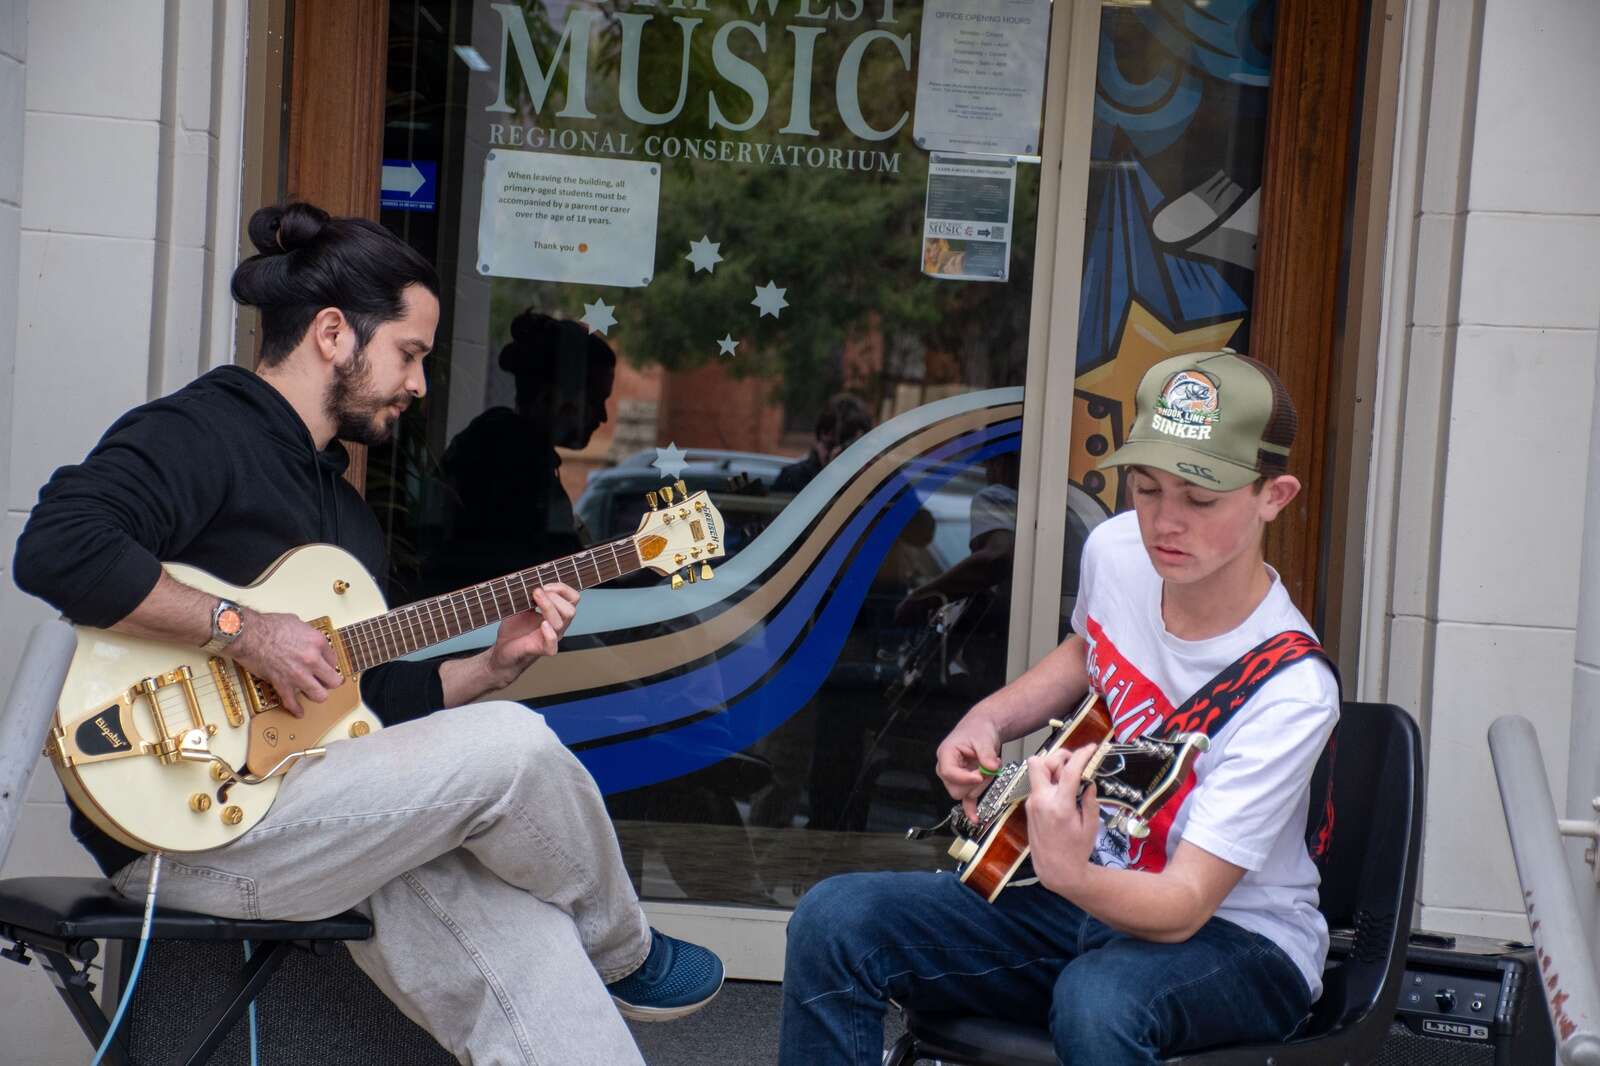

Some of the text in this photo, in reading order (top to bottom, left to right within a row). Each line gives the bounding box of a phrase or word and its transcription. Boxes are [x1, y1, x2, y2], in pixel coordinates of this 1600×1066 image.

[485, 2, 912, 142] MUSIC
[488, 123, 901, 173] REGIONAL CONSERVATORIUM
[507, 170, 625, 189] When leaving the building, all
[503, 184, 626, 201] primary-aged students must be
[498, 196, 551, 208] accompanied
[552, 199, 563, 209] by
[571, 202, 598, 212] parent
[599, 205, 609, 213] or
[610, 206, 631, 215] carer
[515, 210, 612, 226] over the age of 18 years.
[928, 223, 962, 235] MUSIC
[533, 240, 575, 254] Thank you
[1161, 407, 1206, 424] HOOK LINE
[1151, 414, 1212, 440] SINKER
[95, 717, 123, 748] Bigsby
[1426, 1022, 1470, 1035] LINE
